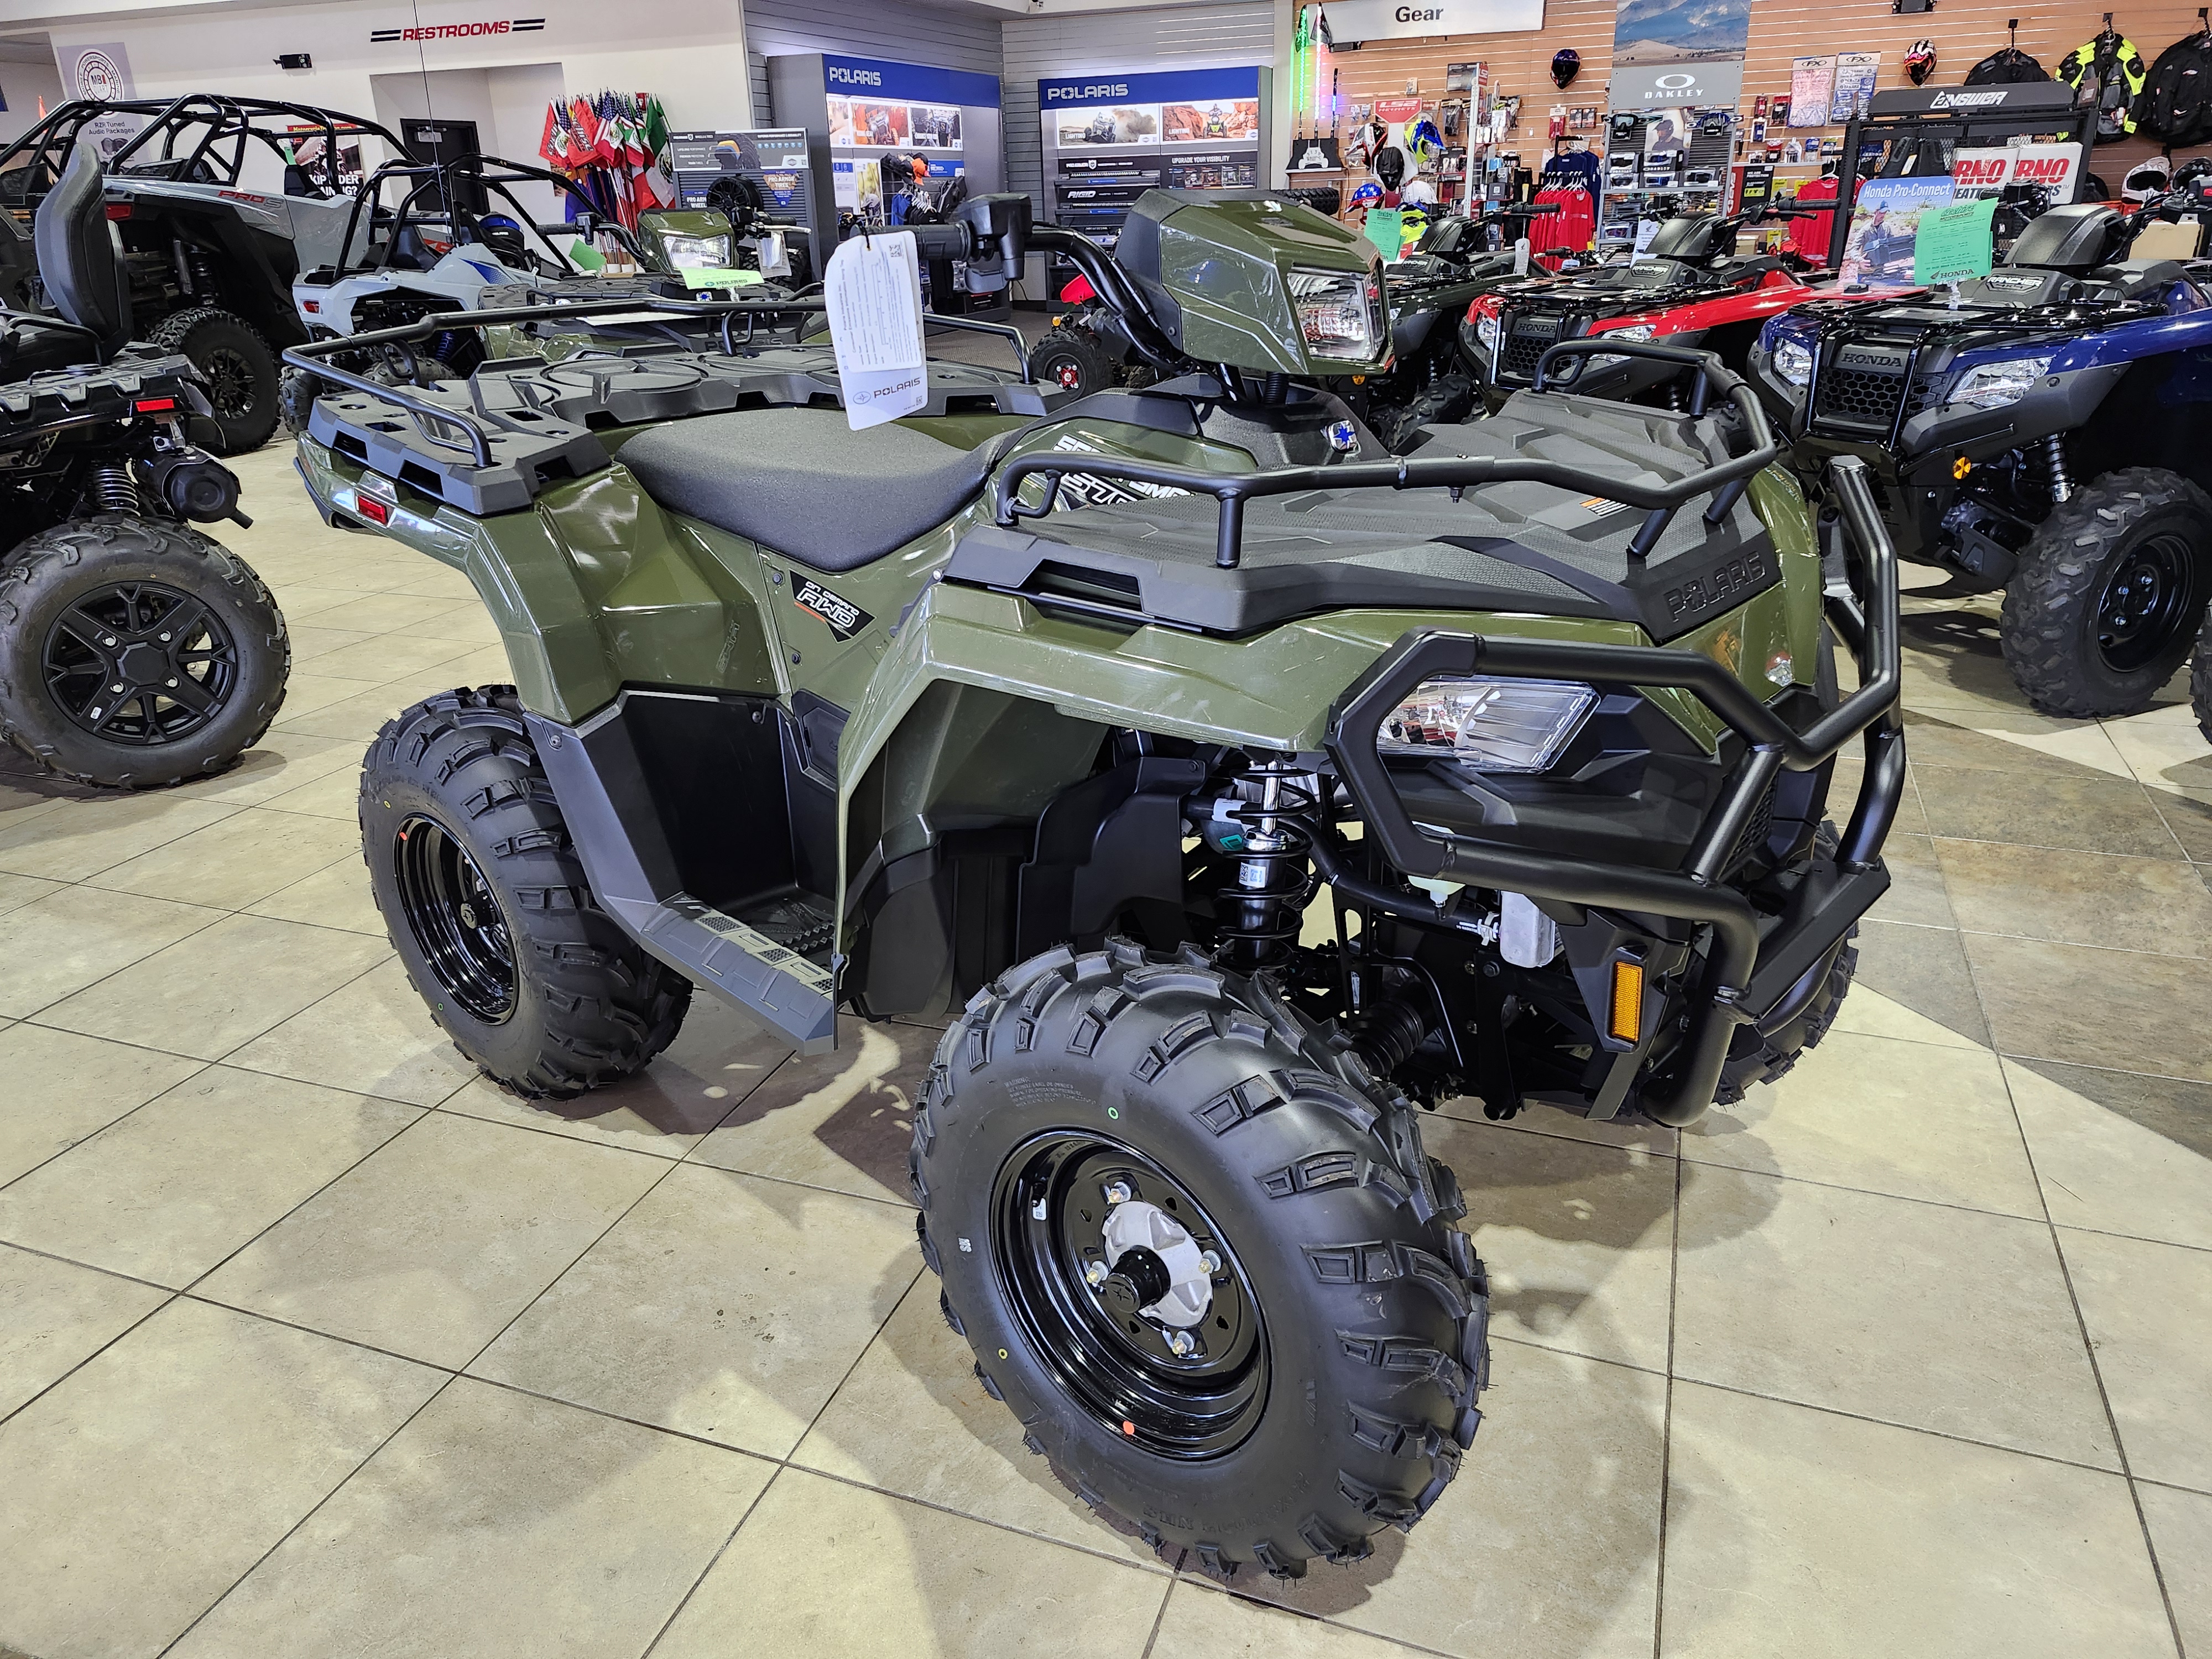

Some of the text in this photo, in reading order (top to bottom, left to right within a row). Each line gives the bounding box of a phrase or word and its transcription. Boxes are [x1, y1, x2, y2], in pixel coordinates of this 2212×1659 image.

[1395, 6, 1444, 23] Gear
[402, 20, 509, 41] RESTROOMS
[829, 66, 882, 86] POLARIS
[1047, 84, 1129, 101] POLARIS
[1644, 88, 1704, 100] OAKLEY
[1929, 91, 2008, 109] ANSWER
[308, 174, 327, 185] KIP
[217, 190, 266, 204] PRO
[1864, 183, 1953, 199] Honda Pro-Connect
[1940, 269, 1975, 278] HONDA
[1987, 276, 2043, 286] RANCHER
[1517, 324, 1556, 332] HONDA
[1842, 353, 1903, 368] HONDA
[873, 377, 922, 399] POLARIS
[1663, 551, 1766, 623] POLARIS
[796, 587, 855, 628] AWD
